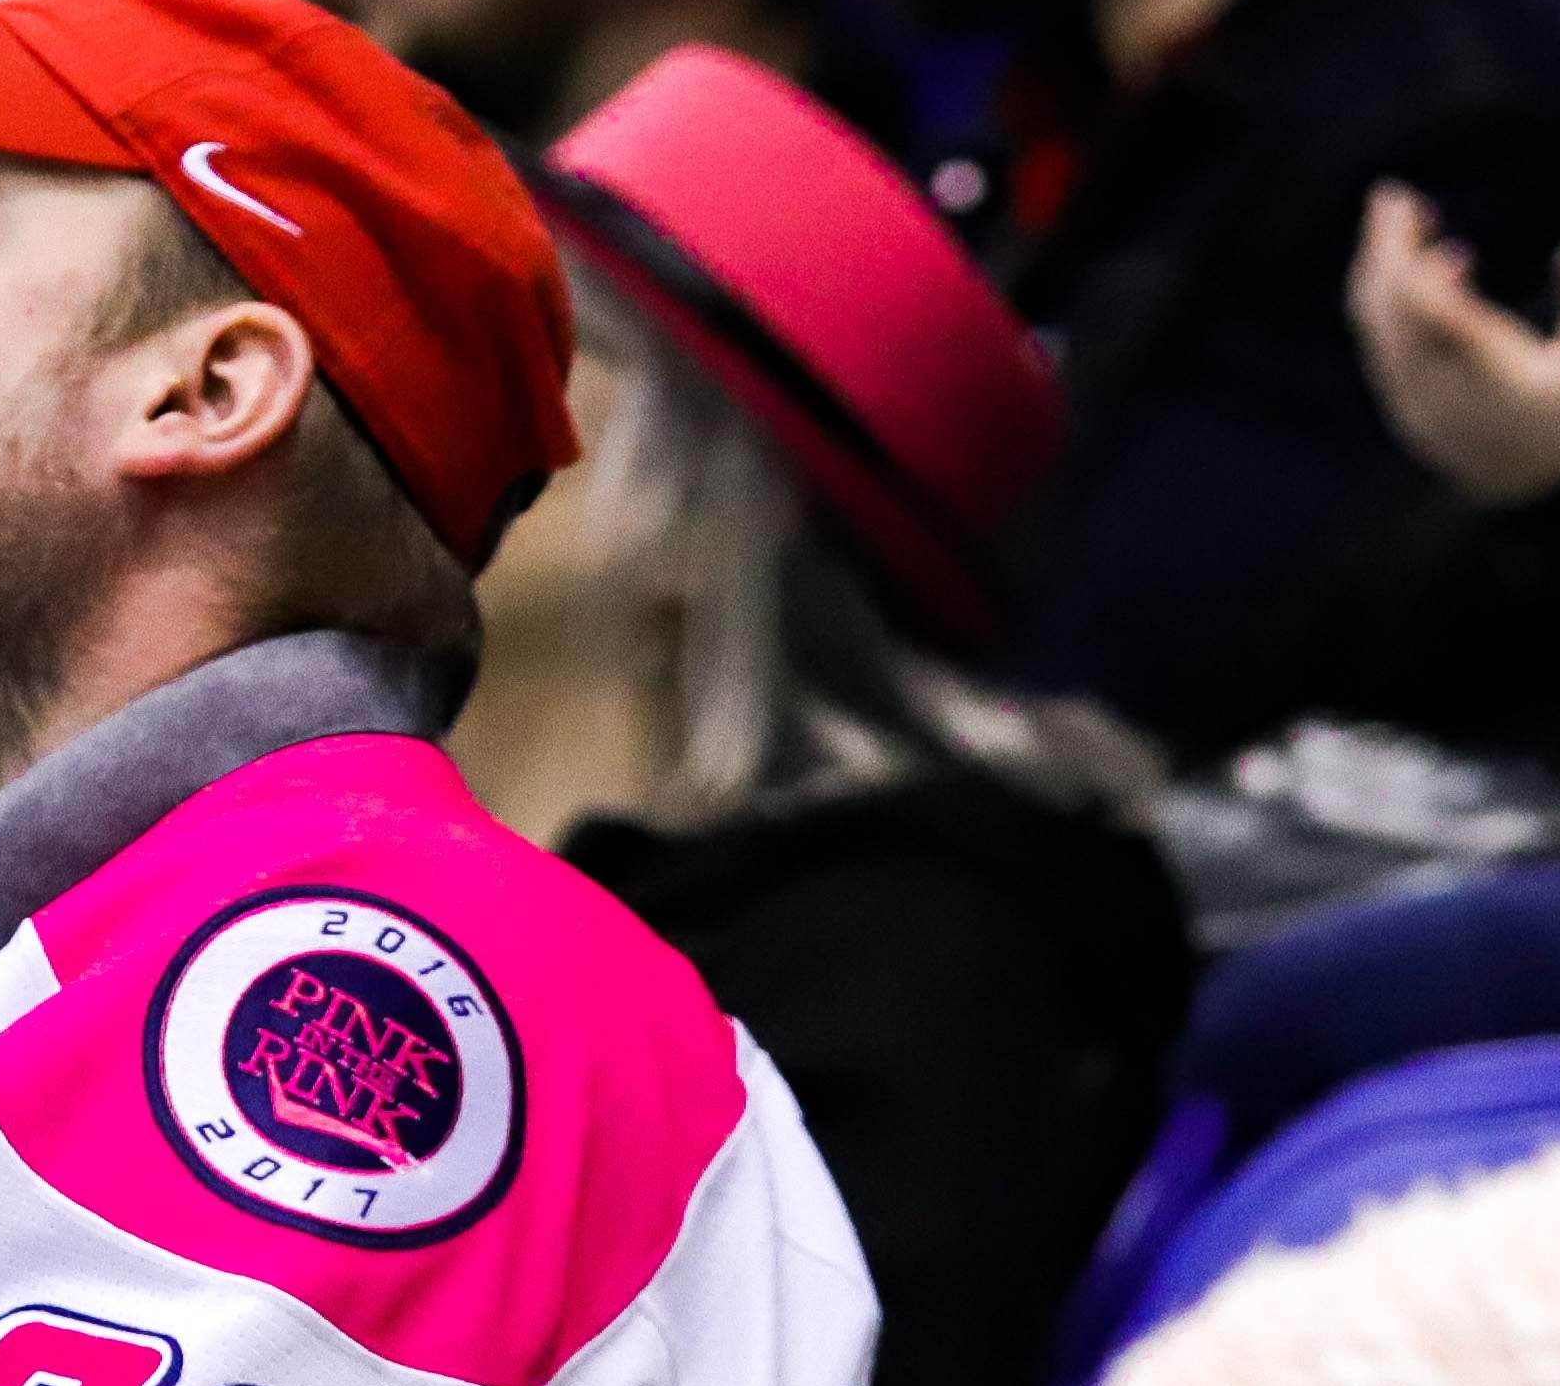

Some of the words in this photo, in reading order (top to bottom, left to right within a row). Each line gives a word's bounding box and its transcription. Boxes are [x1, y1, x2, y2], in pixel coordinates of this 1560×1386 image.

[320, 910, 482, 1018] 2016
[238, 1027, 421, 1146] RINK
[269, 967, 451, 1099] PINK
[196, 1118, 379, 1218] 2017
